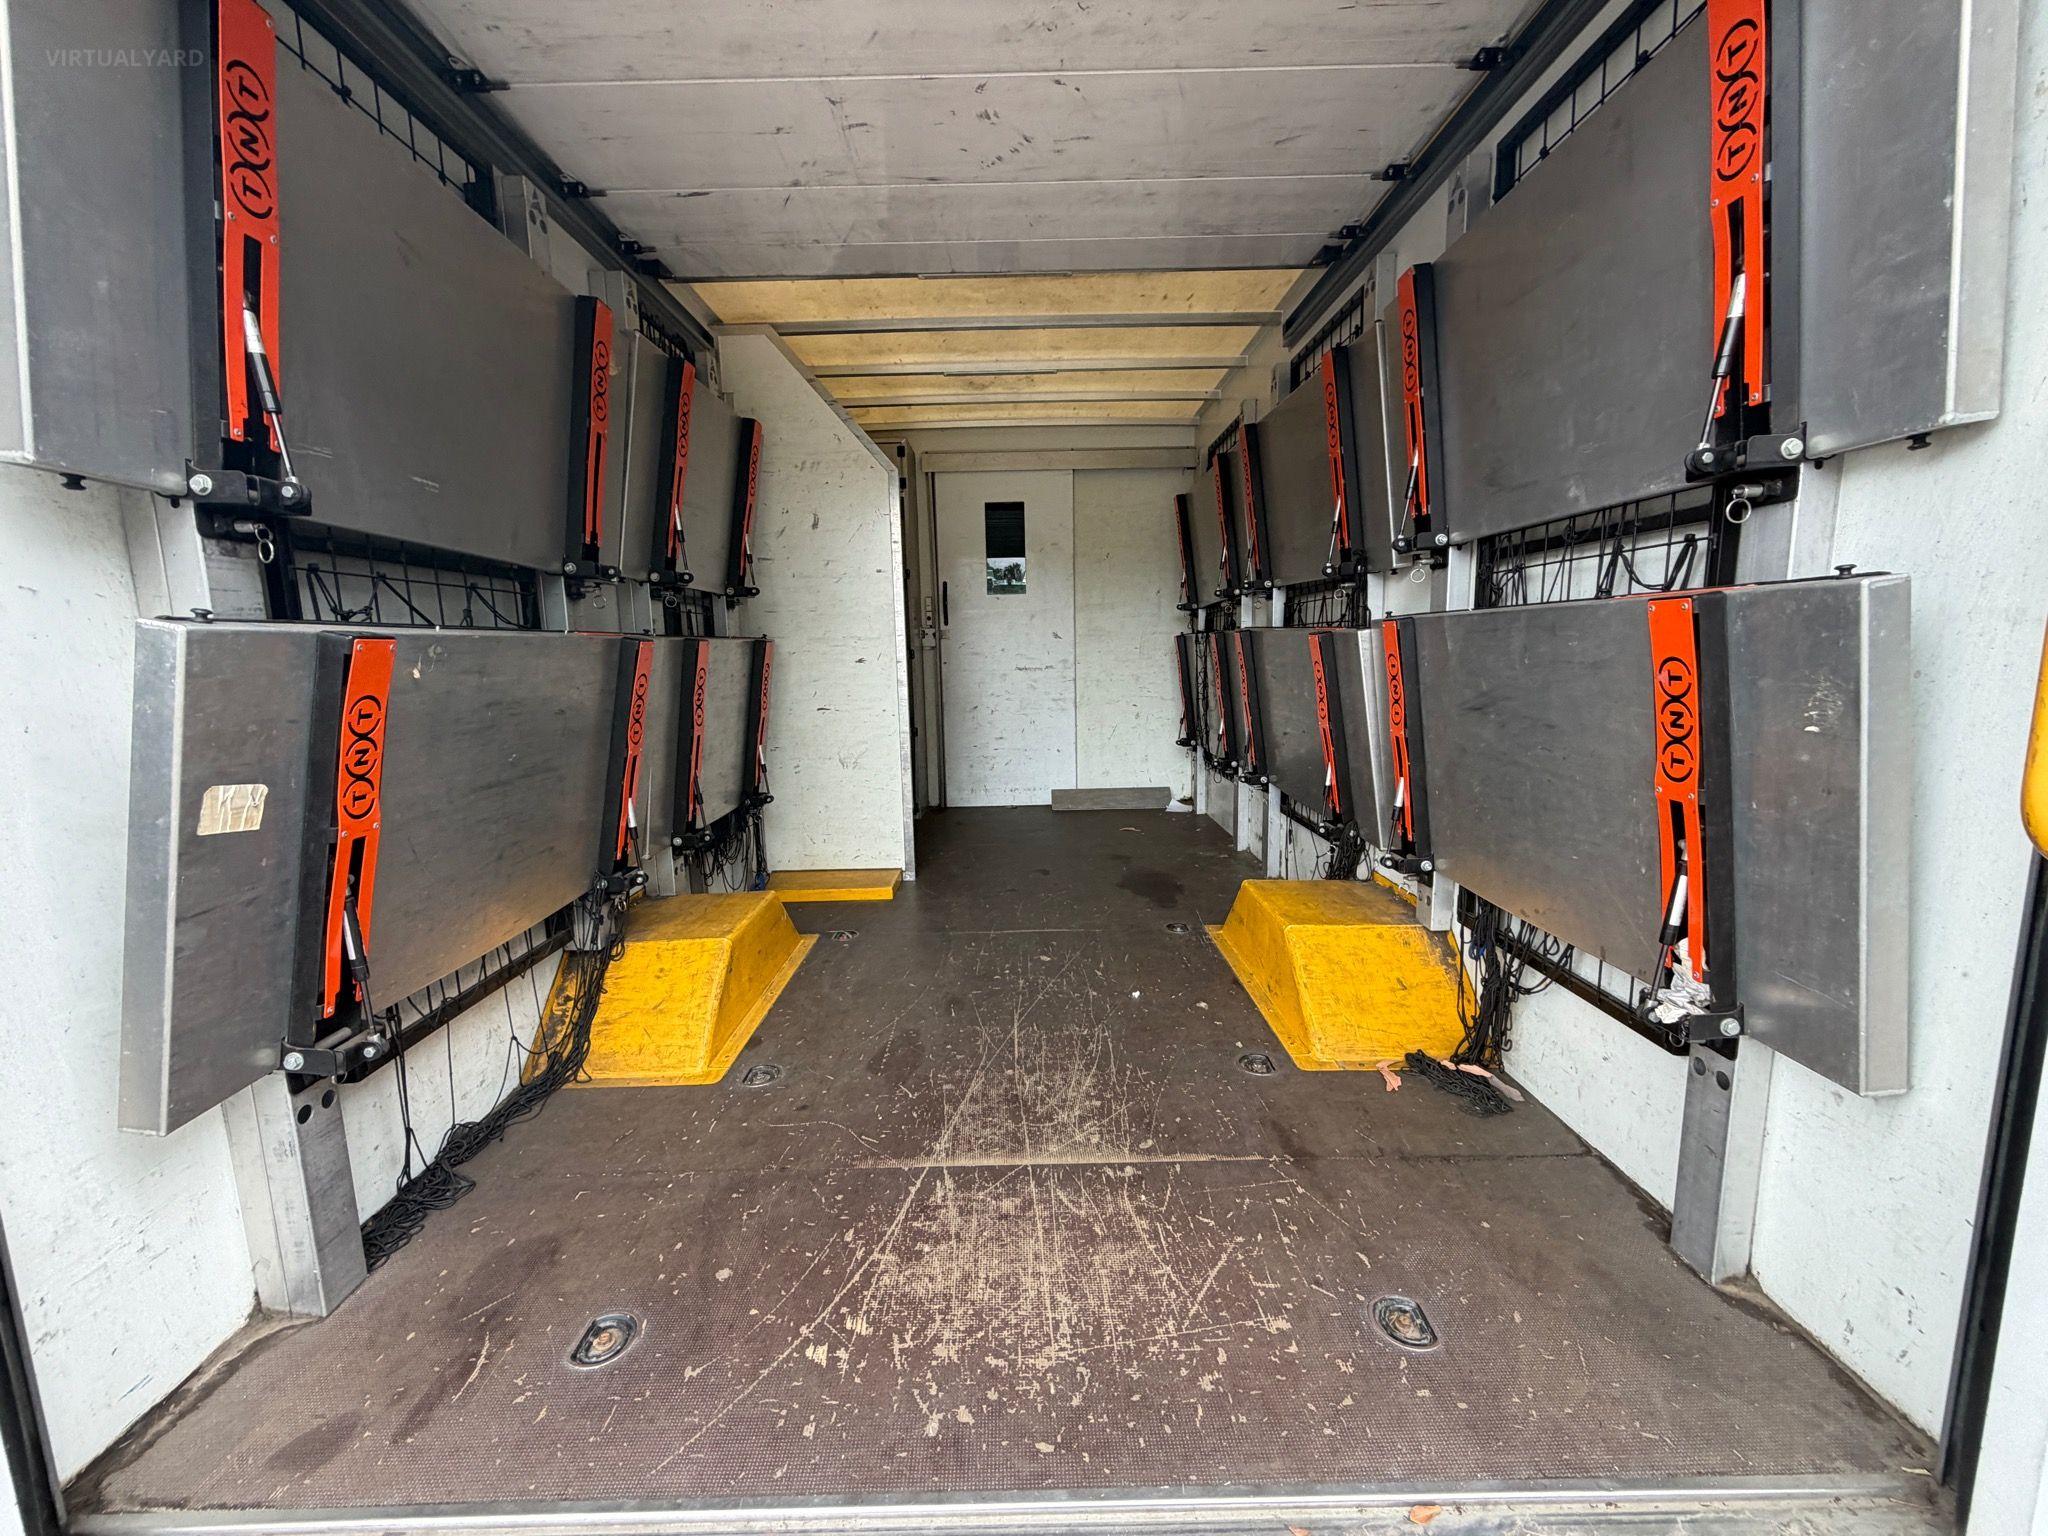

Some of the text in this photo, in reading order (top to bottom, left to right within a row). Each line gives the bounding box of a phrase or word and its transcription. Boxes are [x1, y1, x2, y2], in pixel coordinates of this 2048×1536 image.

[594, 346, 607, 415] TNT
[349, 705, 376, 810] TNT
[1664, 666, 1688, 772] TNT
